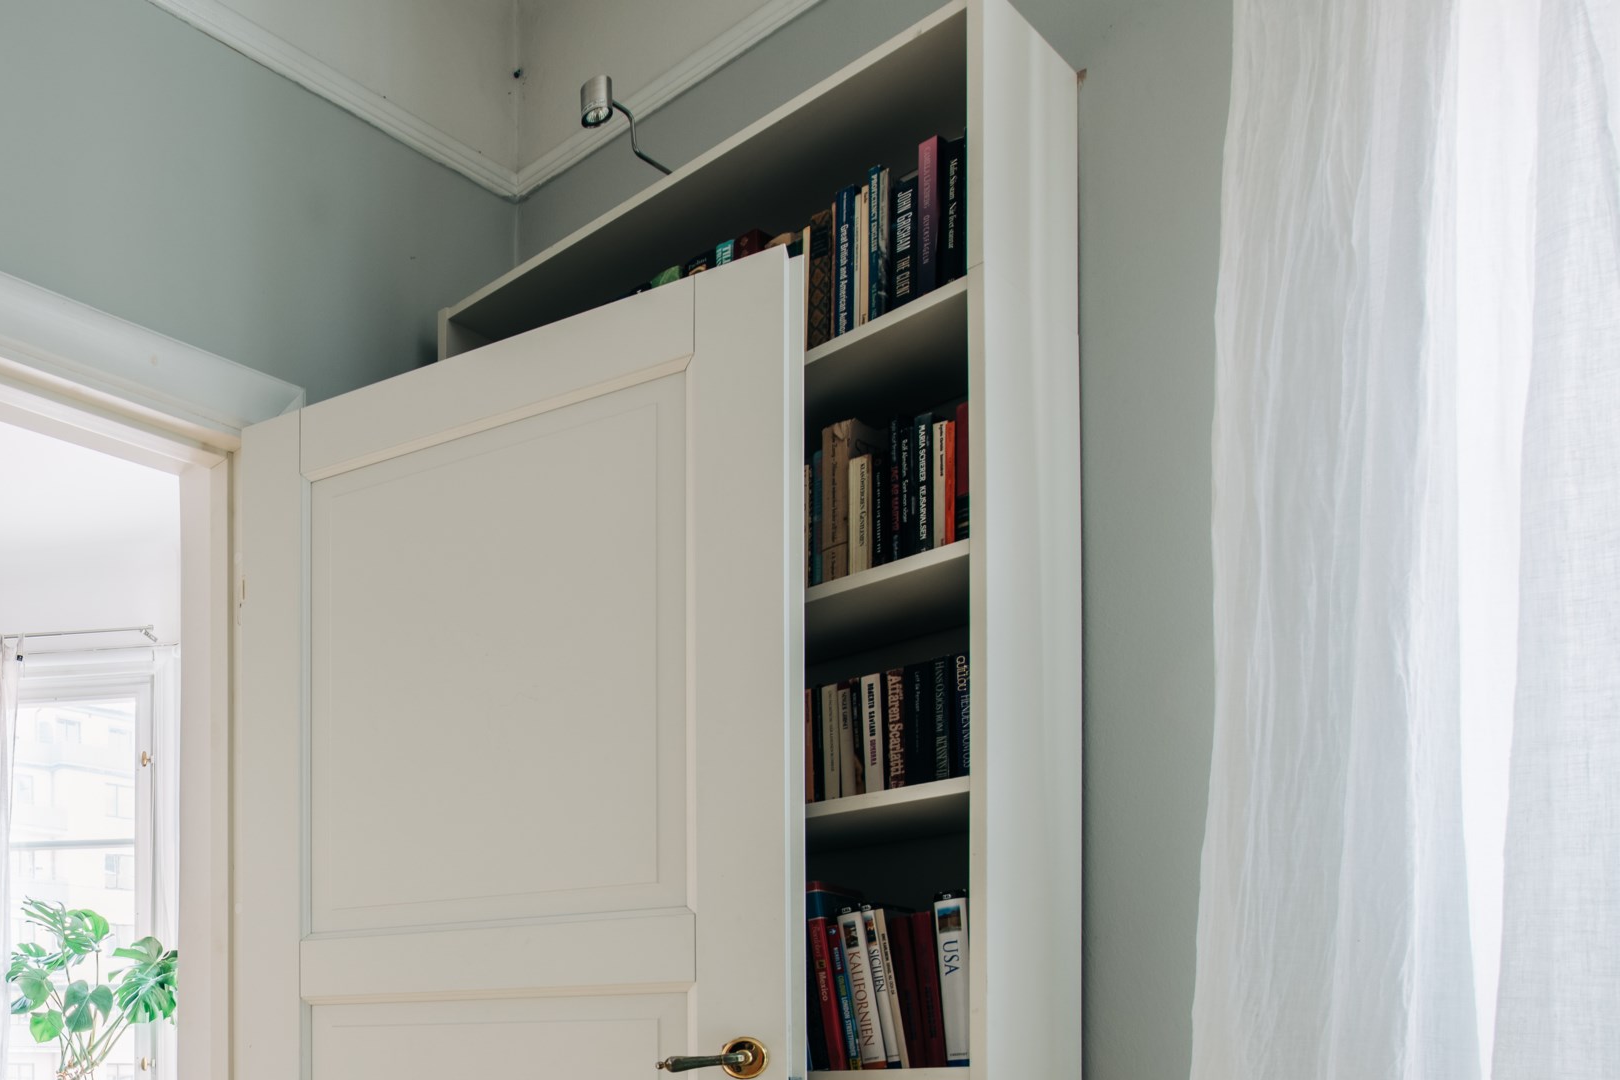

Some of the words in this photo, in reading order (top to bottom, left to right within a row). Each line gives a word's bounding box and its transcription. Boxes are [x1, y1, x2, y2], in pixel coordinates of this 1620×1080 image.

[897, 188, 913, 213] JOHN
[839, 224, 849, 243] Great
[896, 213, 913, 253] GRISHAM
[839, 243, 849, 266] British
[897, 255, 911, 272] THE
[839, 267, 848, 280] and
[896, 272, 910, 298] CLIENT
[839, 280, 848, 312] American
[918, 424, 926, 449] MARIA
[918, 449, 926, 482] SCHERER
[935, 661, 945, 683] HANS
[888, 675, 903, 722] Affären
[889, 723, 905, 777] Scarlatti
[868, 949, 885, 993] SICILIEN
[942, 940, 960, 976] USA
[818, 972, 829, 1001] Mexico
[847, 950, 874, 1047] KALIFORNIEN
[841, 997, 850, 1019] LONDON
